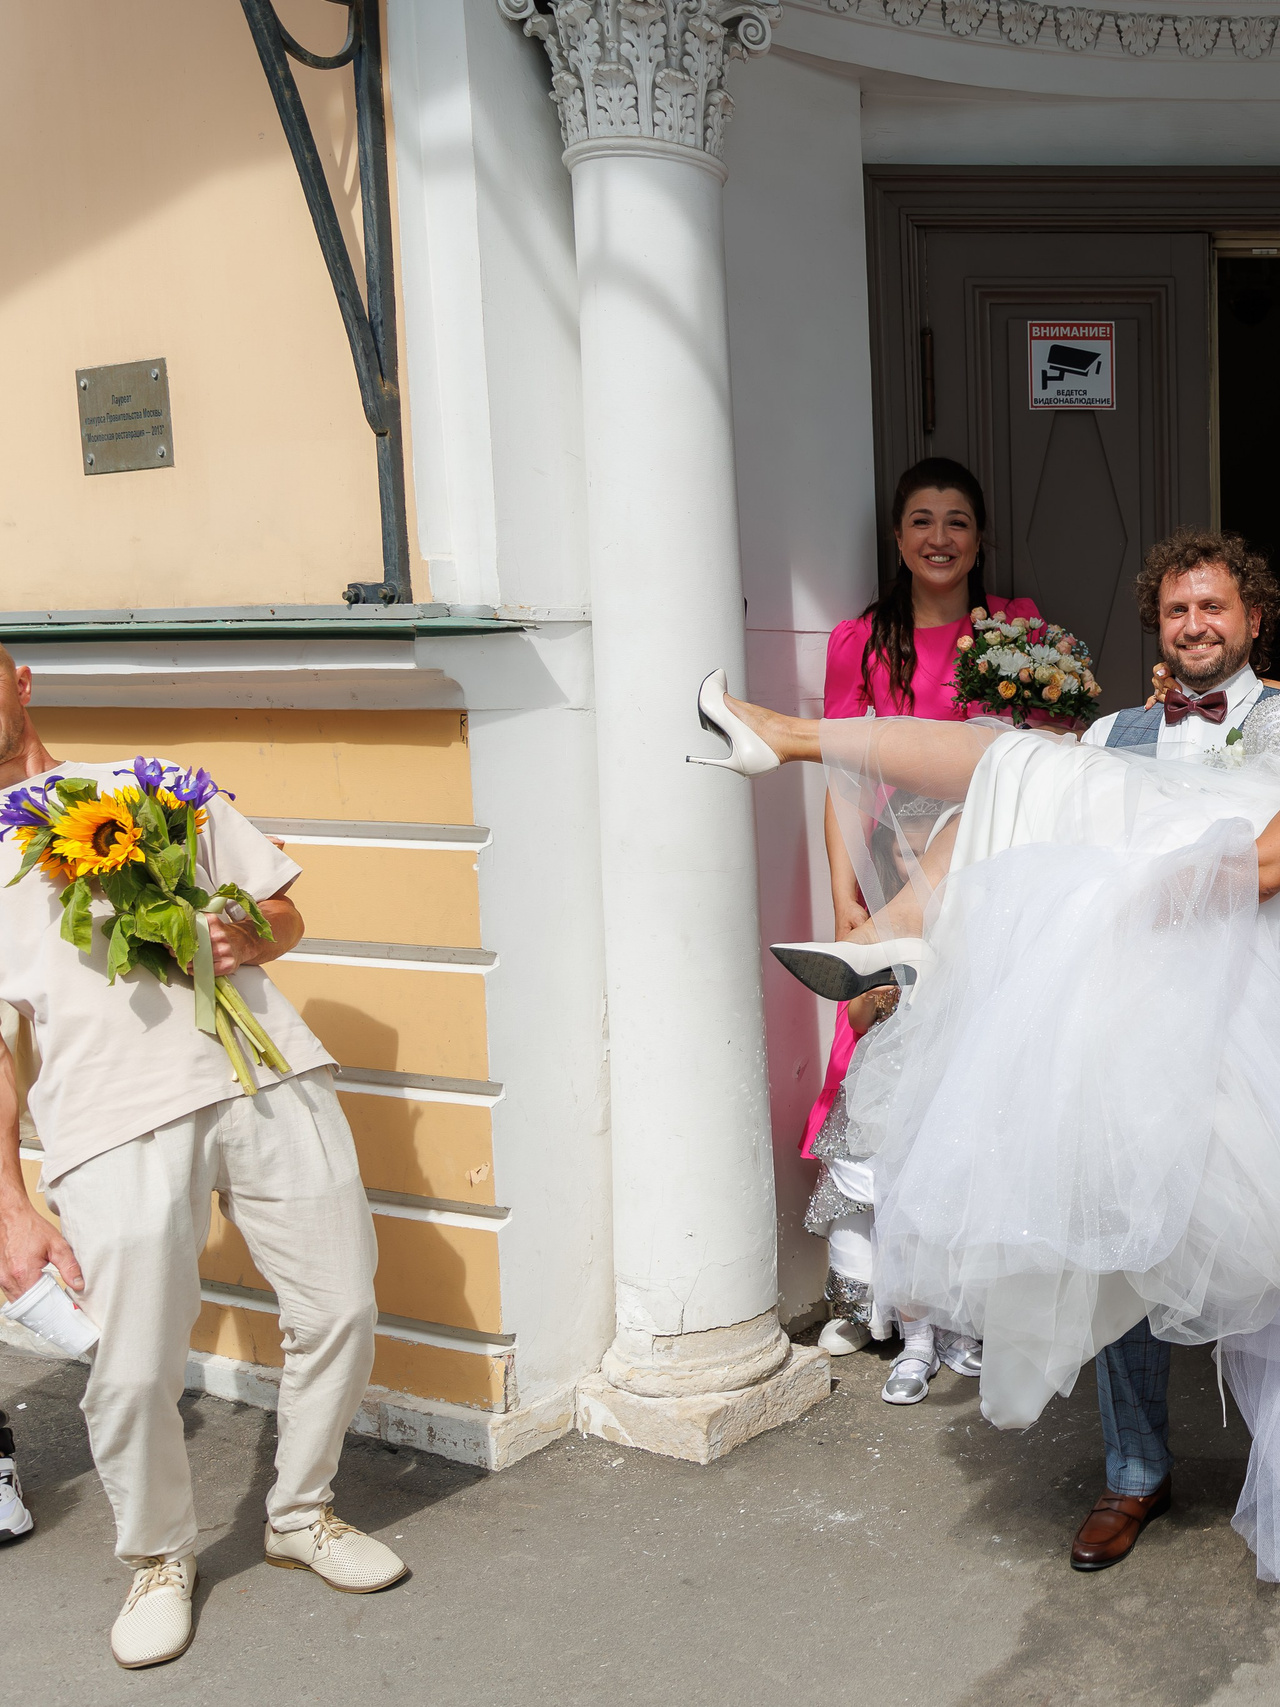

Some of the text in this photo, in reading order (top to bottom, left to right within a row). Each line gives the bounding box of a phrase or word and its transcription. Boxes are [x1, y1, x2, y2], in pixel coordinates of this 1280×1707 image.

[1032, 326, 1110, 337] ВНИМАНИЕ!
[111, 394, 132, 406] Лауреат
[1033, 397, 1111, 405] ВИДЕОНАБЛЮДЕНИЕ
[84, 407, 163, 427] конкурса Правительства Москвы
